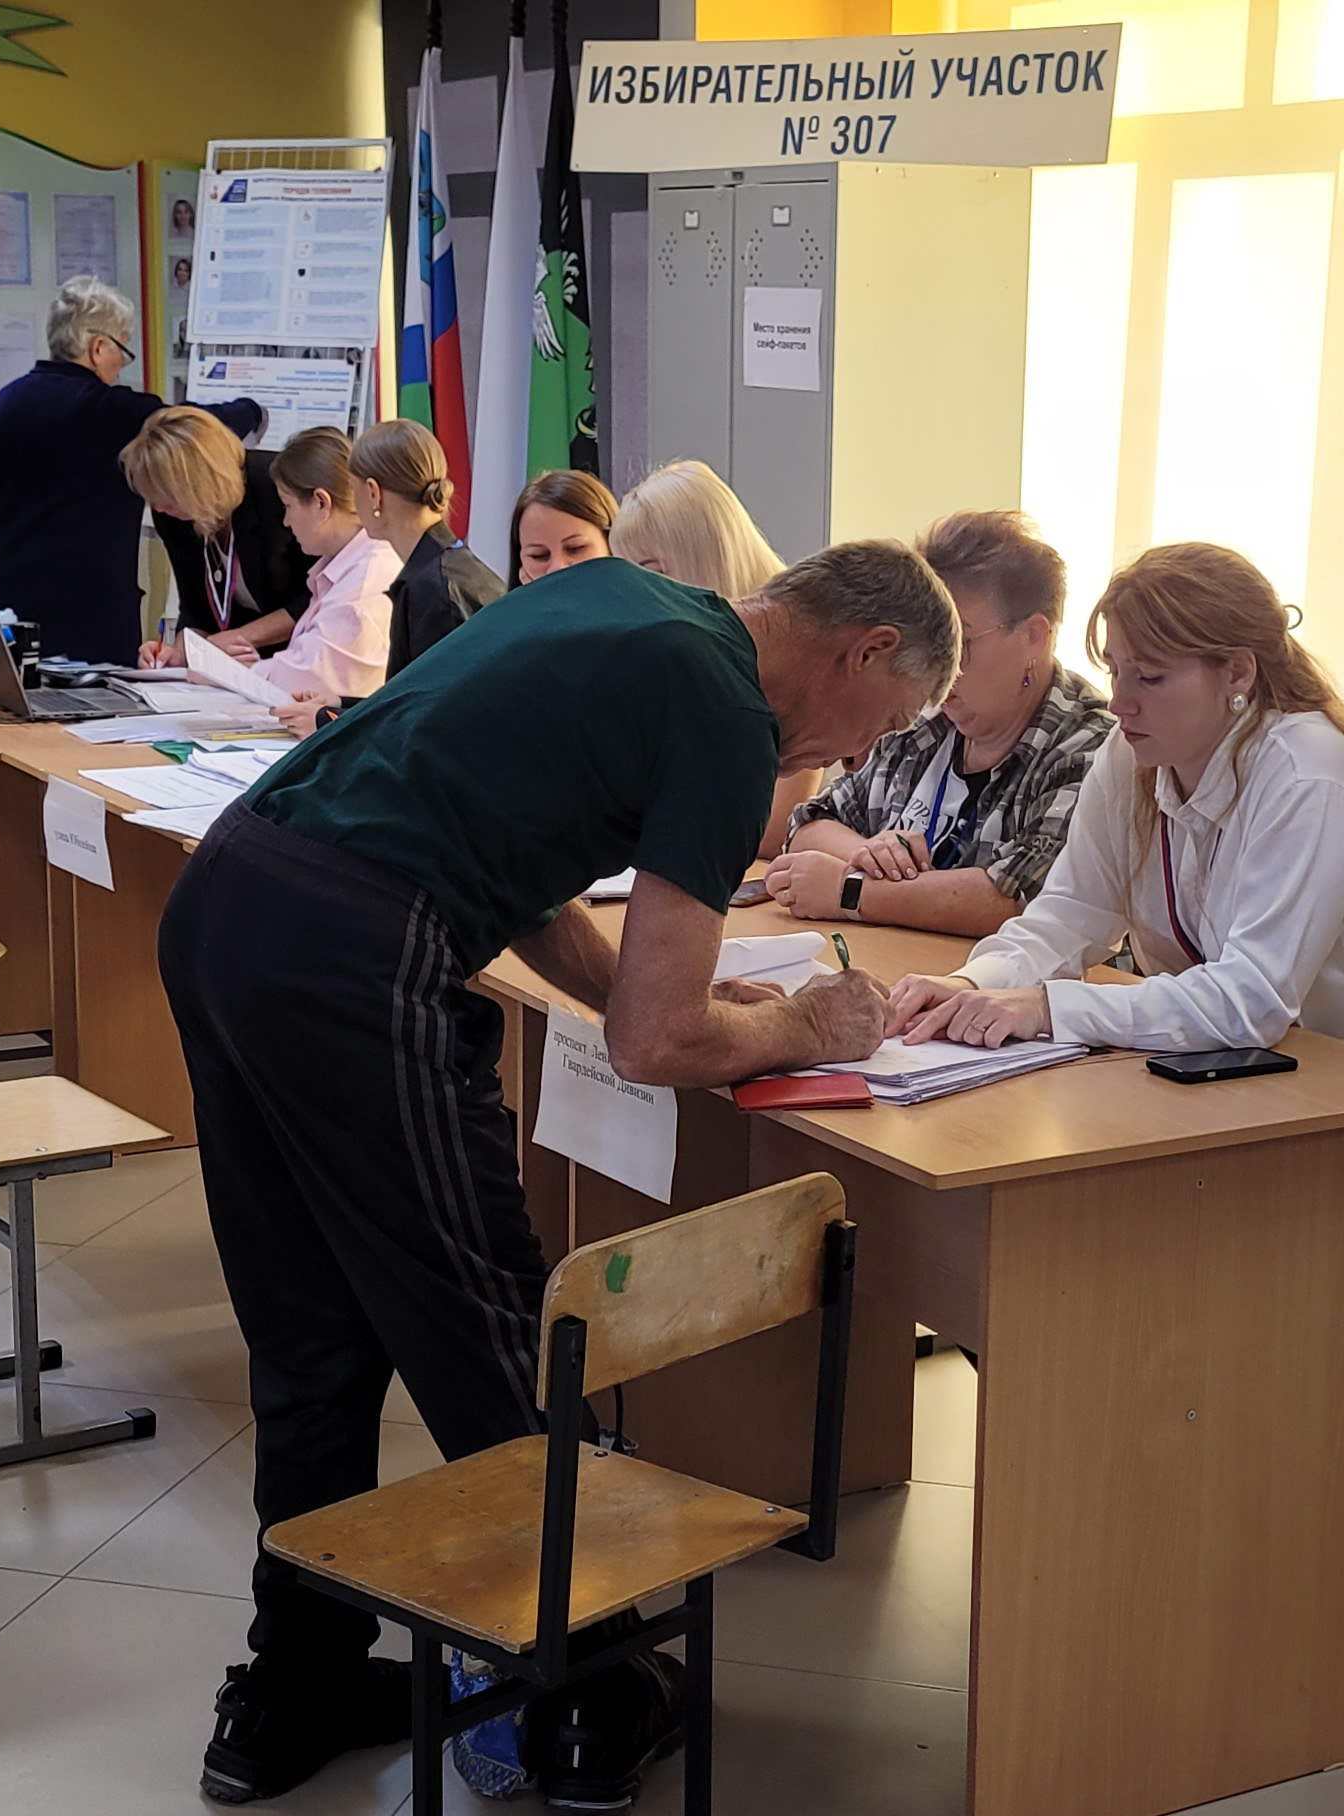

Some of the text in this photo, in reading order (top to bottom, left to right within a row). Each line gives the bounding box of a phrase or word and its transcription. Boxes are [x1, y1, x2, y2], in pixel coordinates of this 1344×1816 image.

[587, 48, 1109, 105] ИЗБИРАТЕЛЬНЫЙ УЧАСТОК
[781, 115, 897, 156] № 307
[554, 1031, 587, 1055] проспект
[562, 1053, 654, 1105] Гвардейской Дивизии
